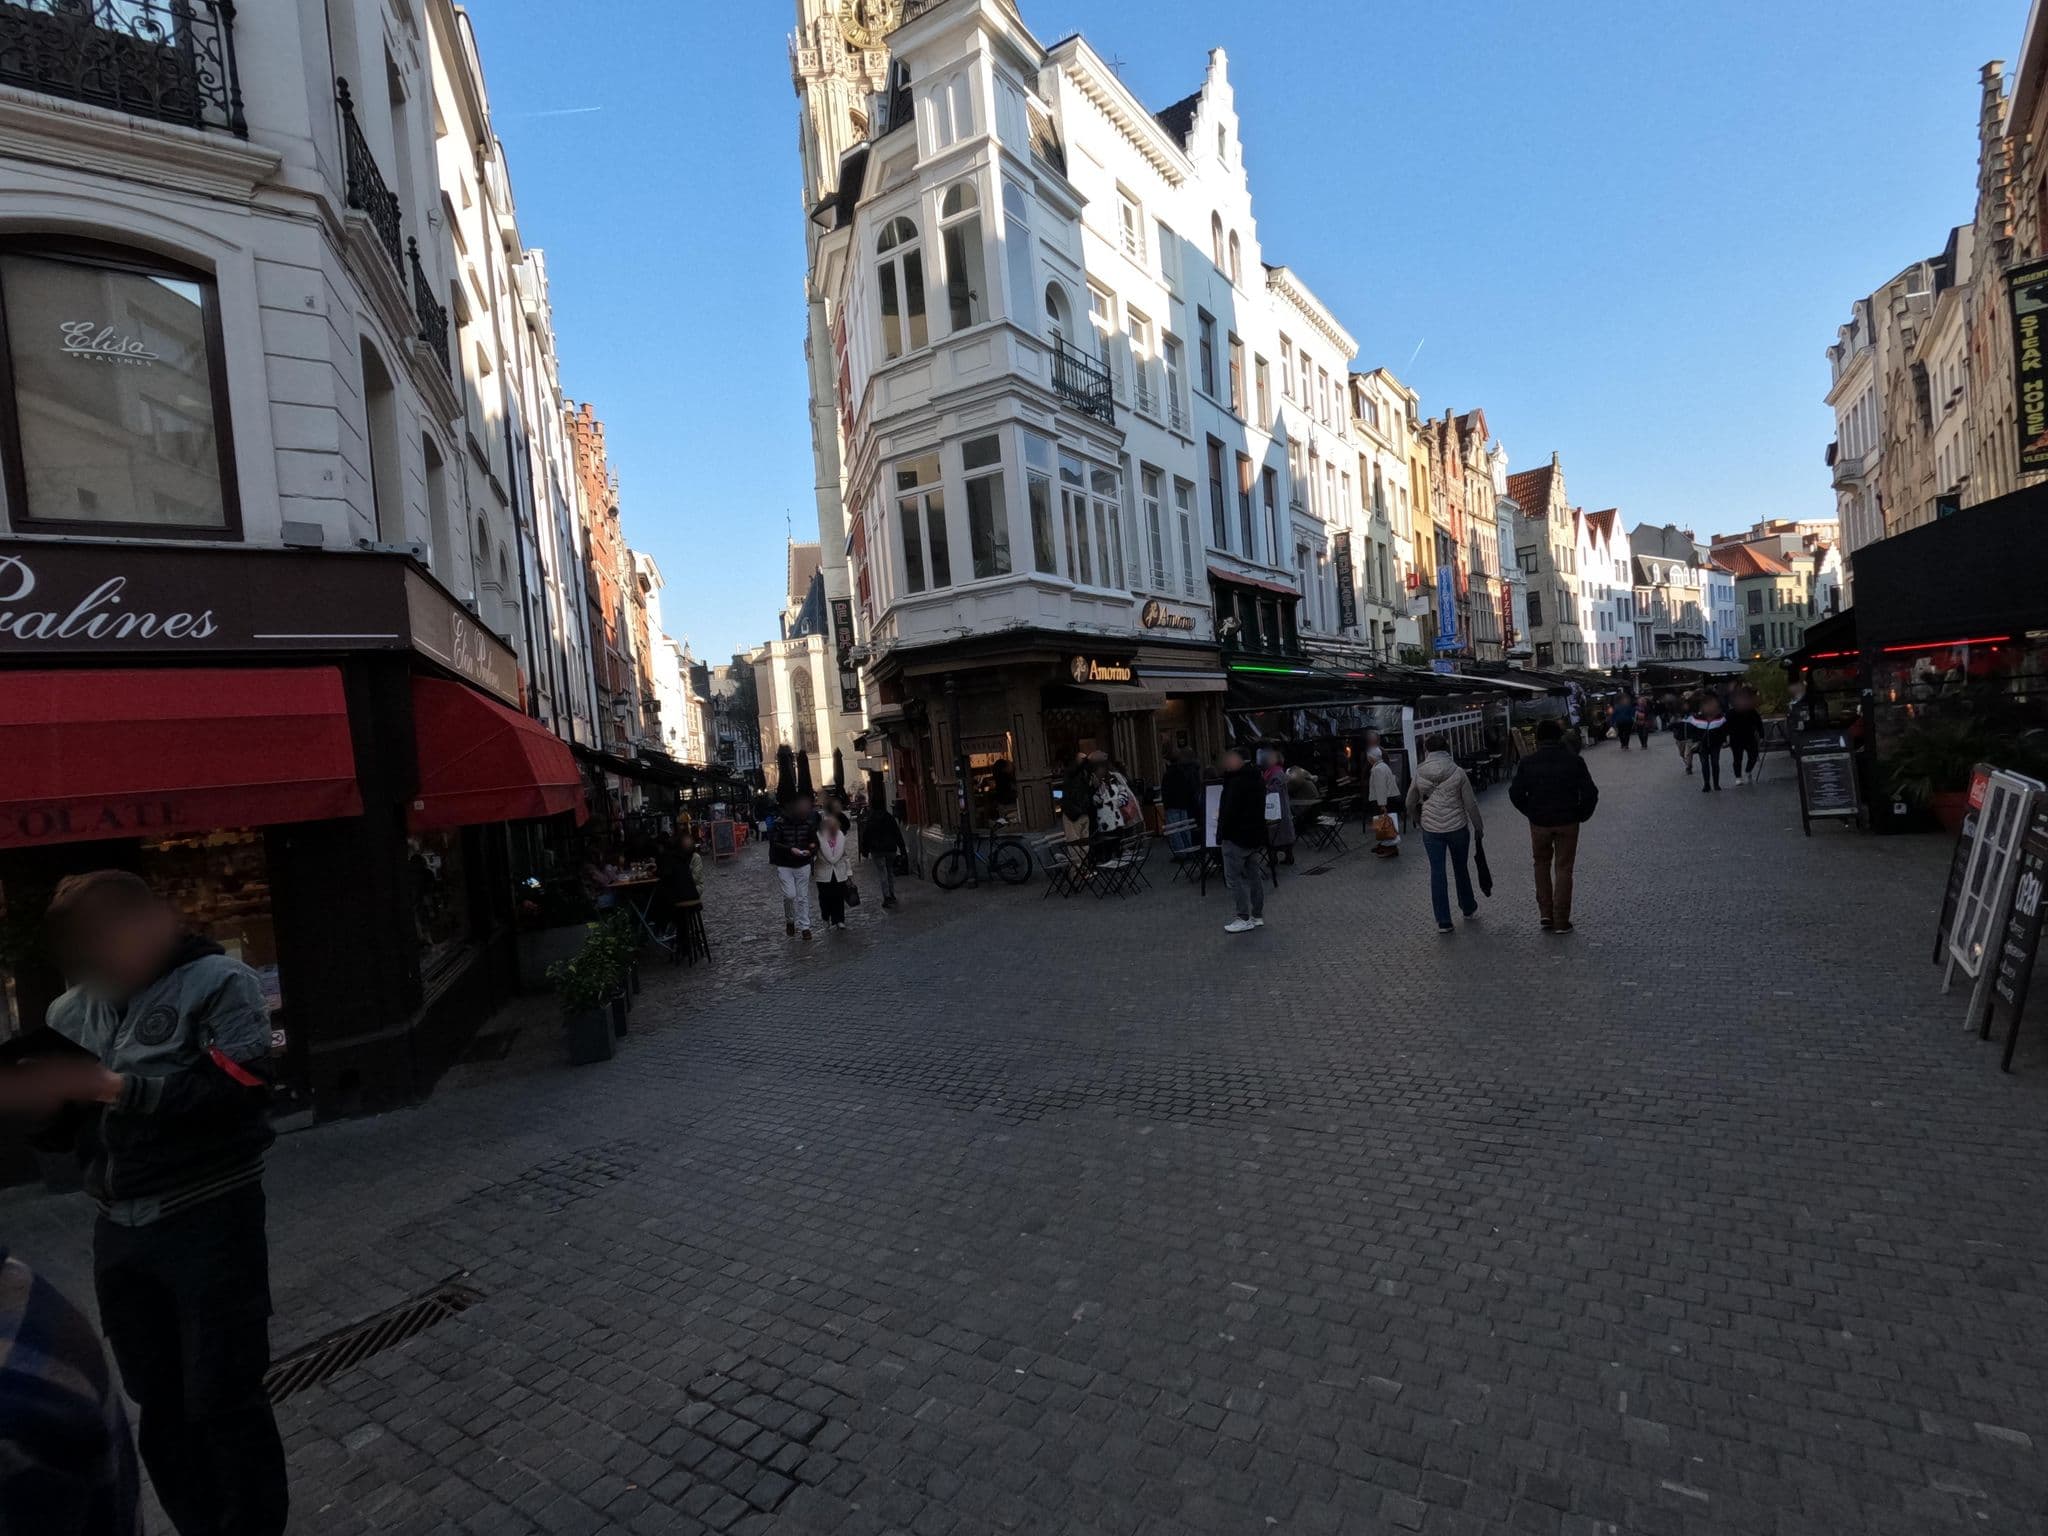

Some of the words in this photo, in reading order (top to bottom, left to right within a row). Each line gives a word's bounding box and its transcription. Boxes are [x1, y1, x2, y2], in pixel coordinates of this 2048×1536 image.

[60, 322, 146, 353] Elisa
[2020, 315, 2042, 371] STEAK
[2023, 379, 2044, 435] HOUSE
[1157, 606, 1196, 631] Amorino
[1502, 585, 1513, 648] PIZZERIA
[1089, 659, 1131, 681] Amorino
